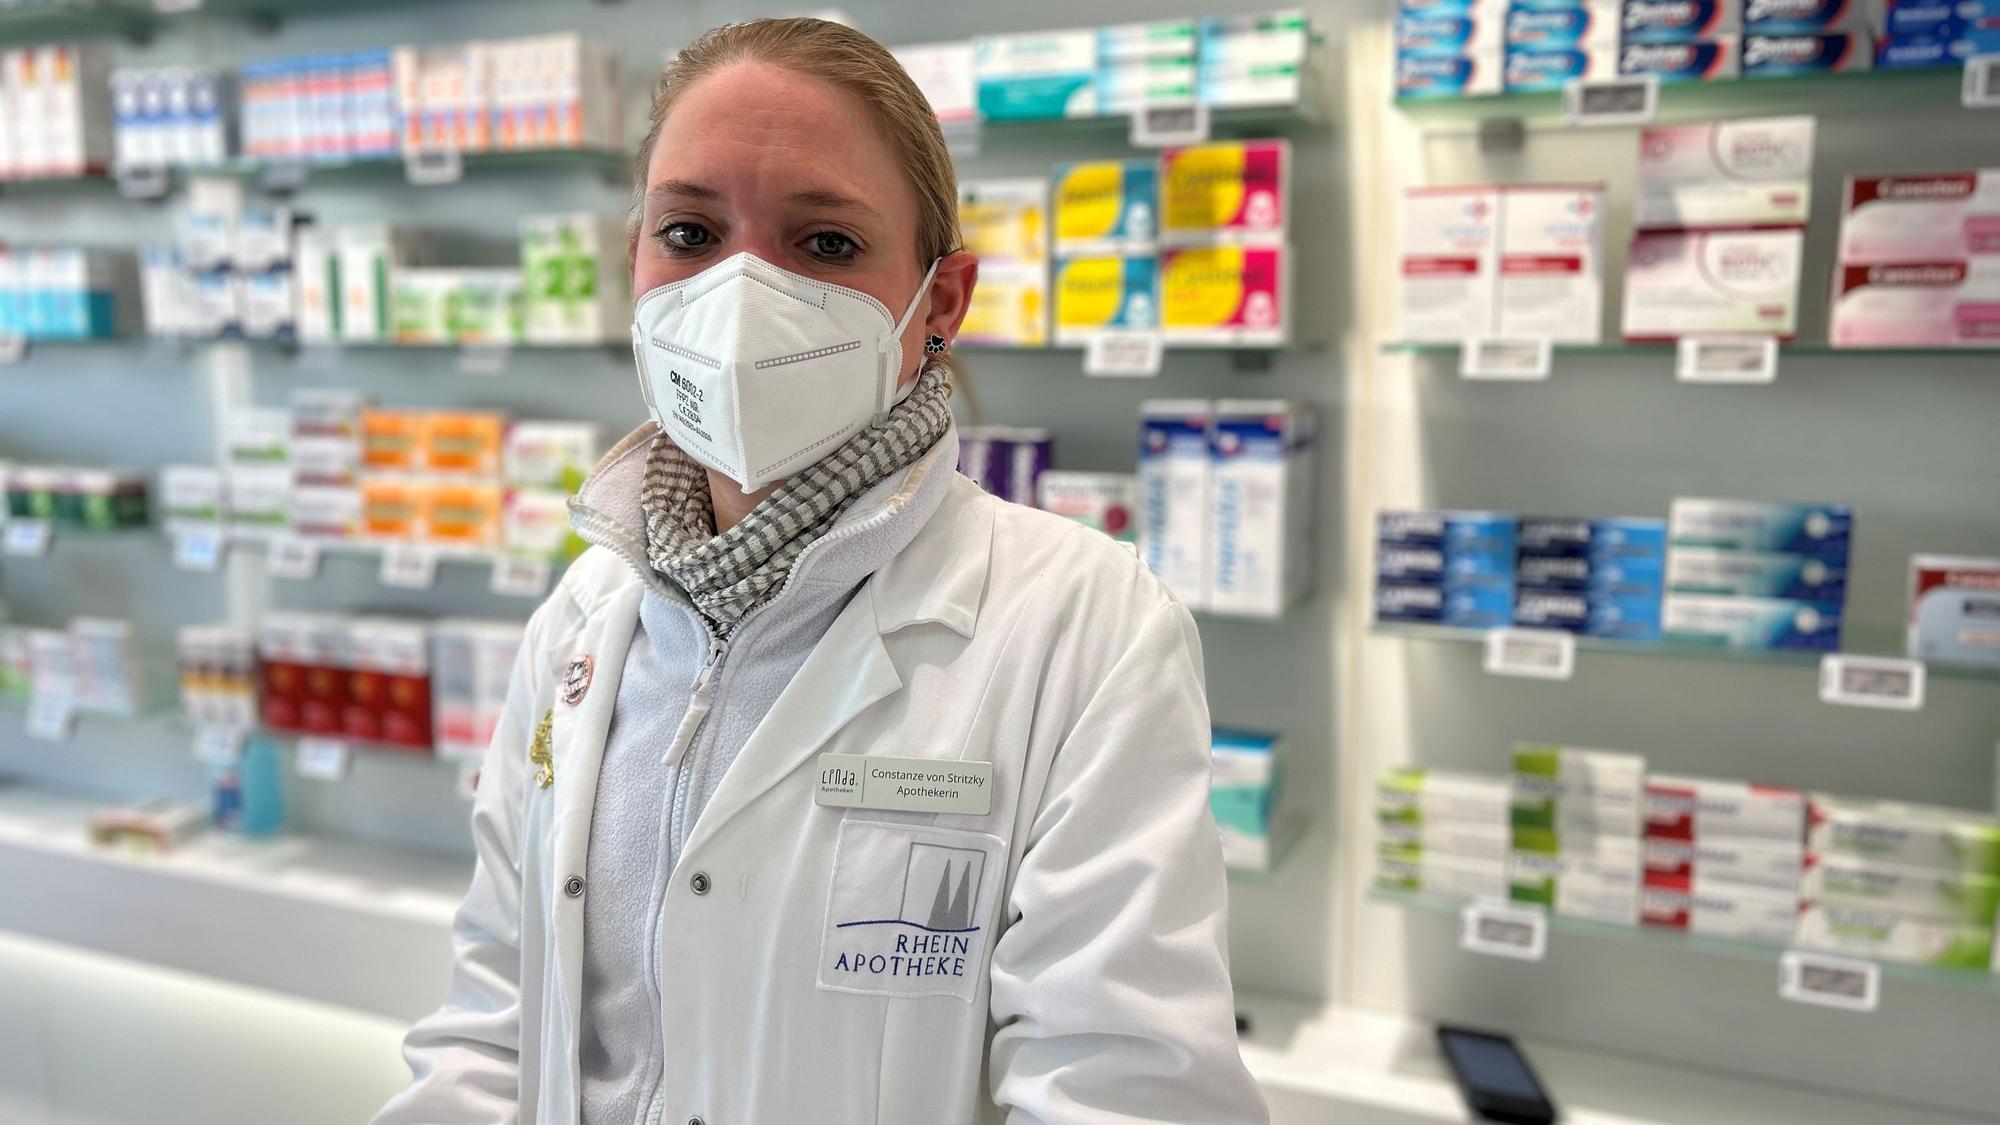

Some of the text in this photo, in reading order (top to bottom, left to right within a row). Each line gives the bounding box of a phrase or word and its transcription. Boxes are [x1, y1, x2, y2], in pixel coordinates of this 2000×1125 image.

[871, 768, 985, 788] Constanze von Stritzky
[896, 785, 959, 799] Apothekerin
[895, 933, 969, 955] RHEIN
[834, 952, 966, 977] APOTHEKE
